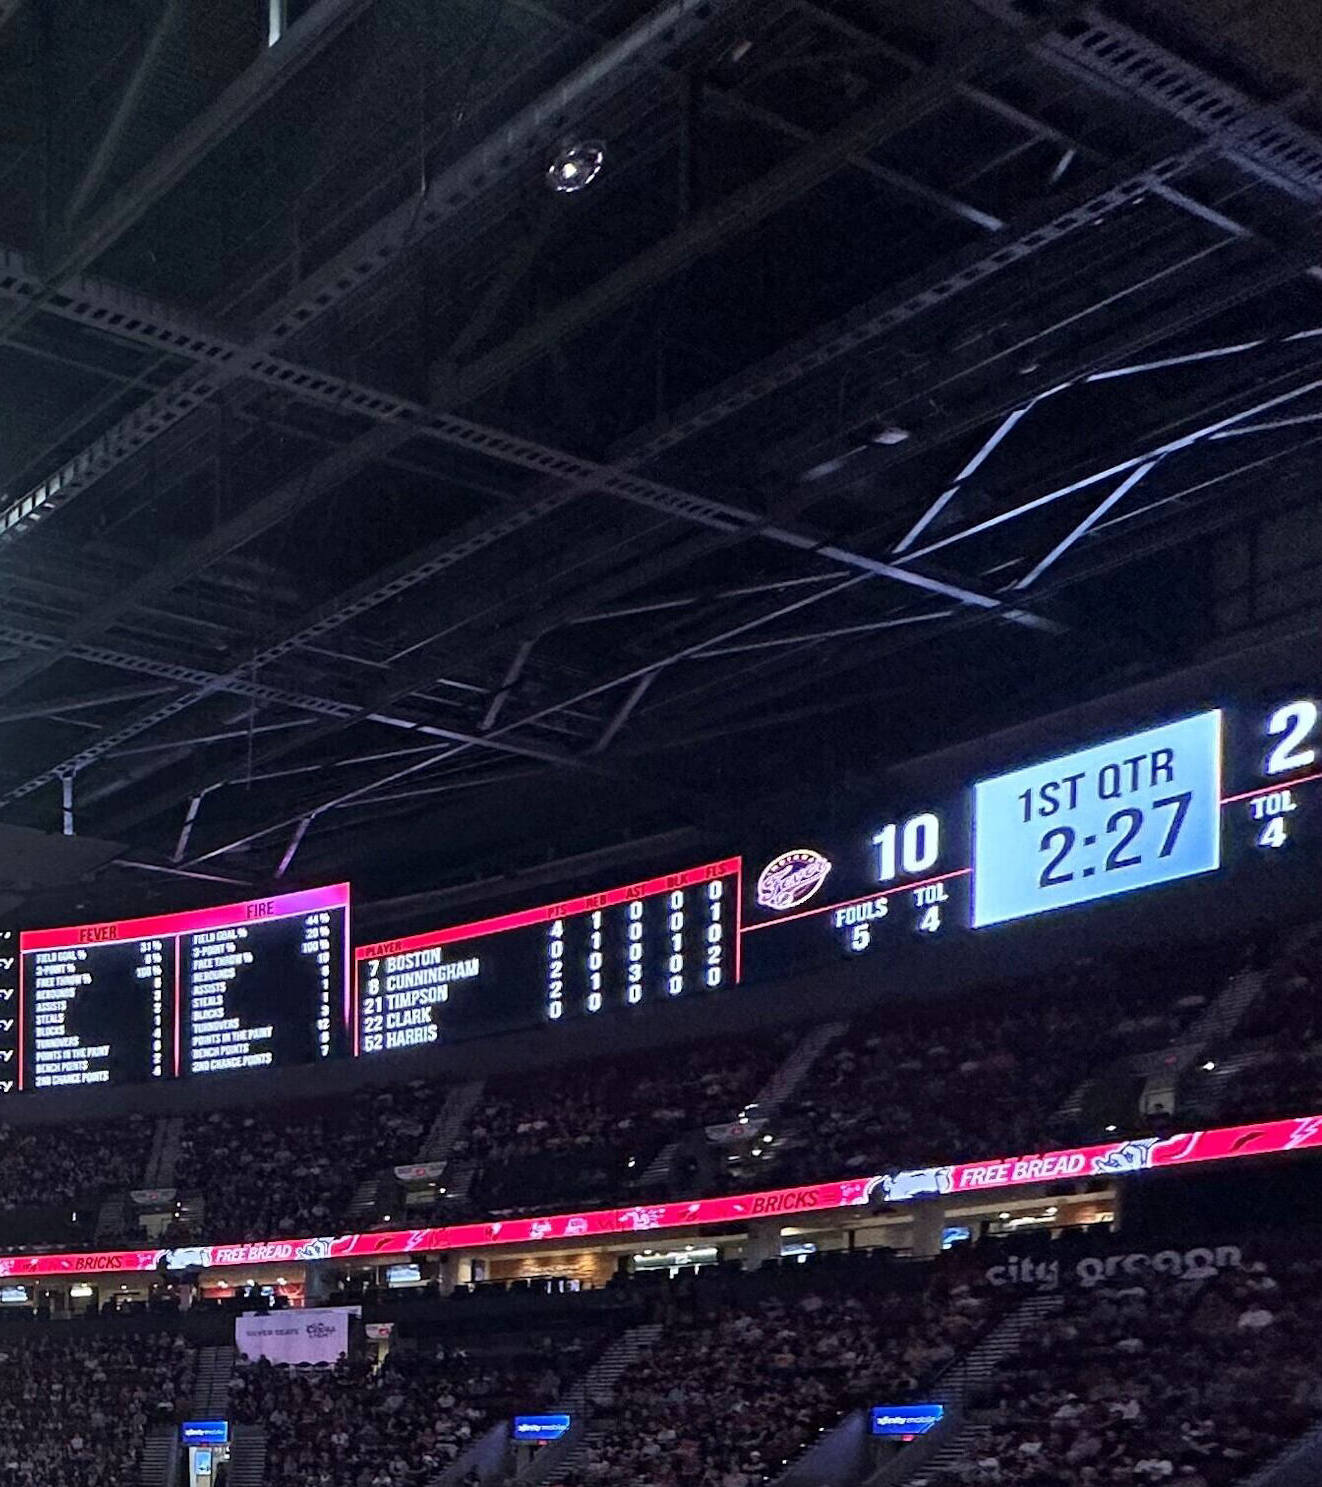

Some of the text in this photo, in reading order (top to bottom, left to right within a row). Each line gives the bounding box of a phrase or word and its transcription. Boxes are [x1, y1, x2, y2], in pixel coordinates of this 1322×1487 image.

[1018, 746, 1176, 824] 1ST QTR
[871, 812, 940, 882] 10
[1038, 790, 1193, 890] 2:27
[1258, 818, 1287, 849] 4
[79, 901, 275, 942] FEVER FIRE
[835, 896, 889, 928] FOULS
[850, 906, 941, 952] 5 4
[386, 947, 442, 973] BOSTON
[386, 957, 480, 992] CUNNINGHAM
[364, 996, 383, 1016] 21
[386, 984, 449, 1011] TIMPSON
[364, 1016, 383, 1035] 22
[386, 1007, 432, 1030] CLARK
[364, 1034, 383, 1052] 52
[386, 1024, 438, 1049] HARRIS
[753, 1154, 1086, 1212] BRICKS FREE BREAD
[75, 1244, 292, 1271] BRICKS FREE BREAD
